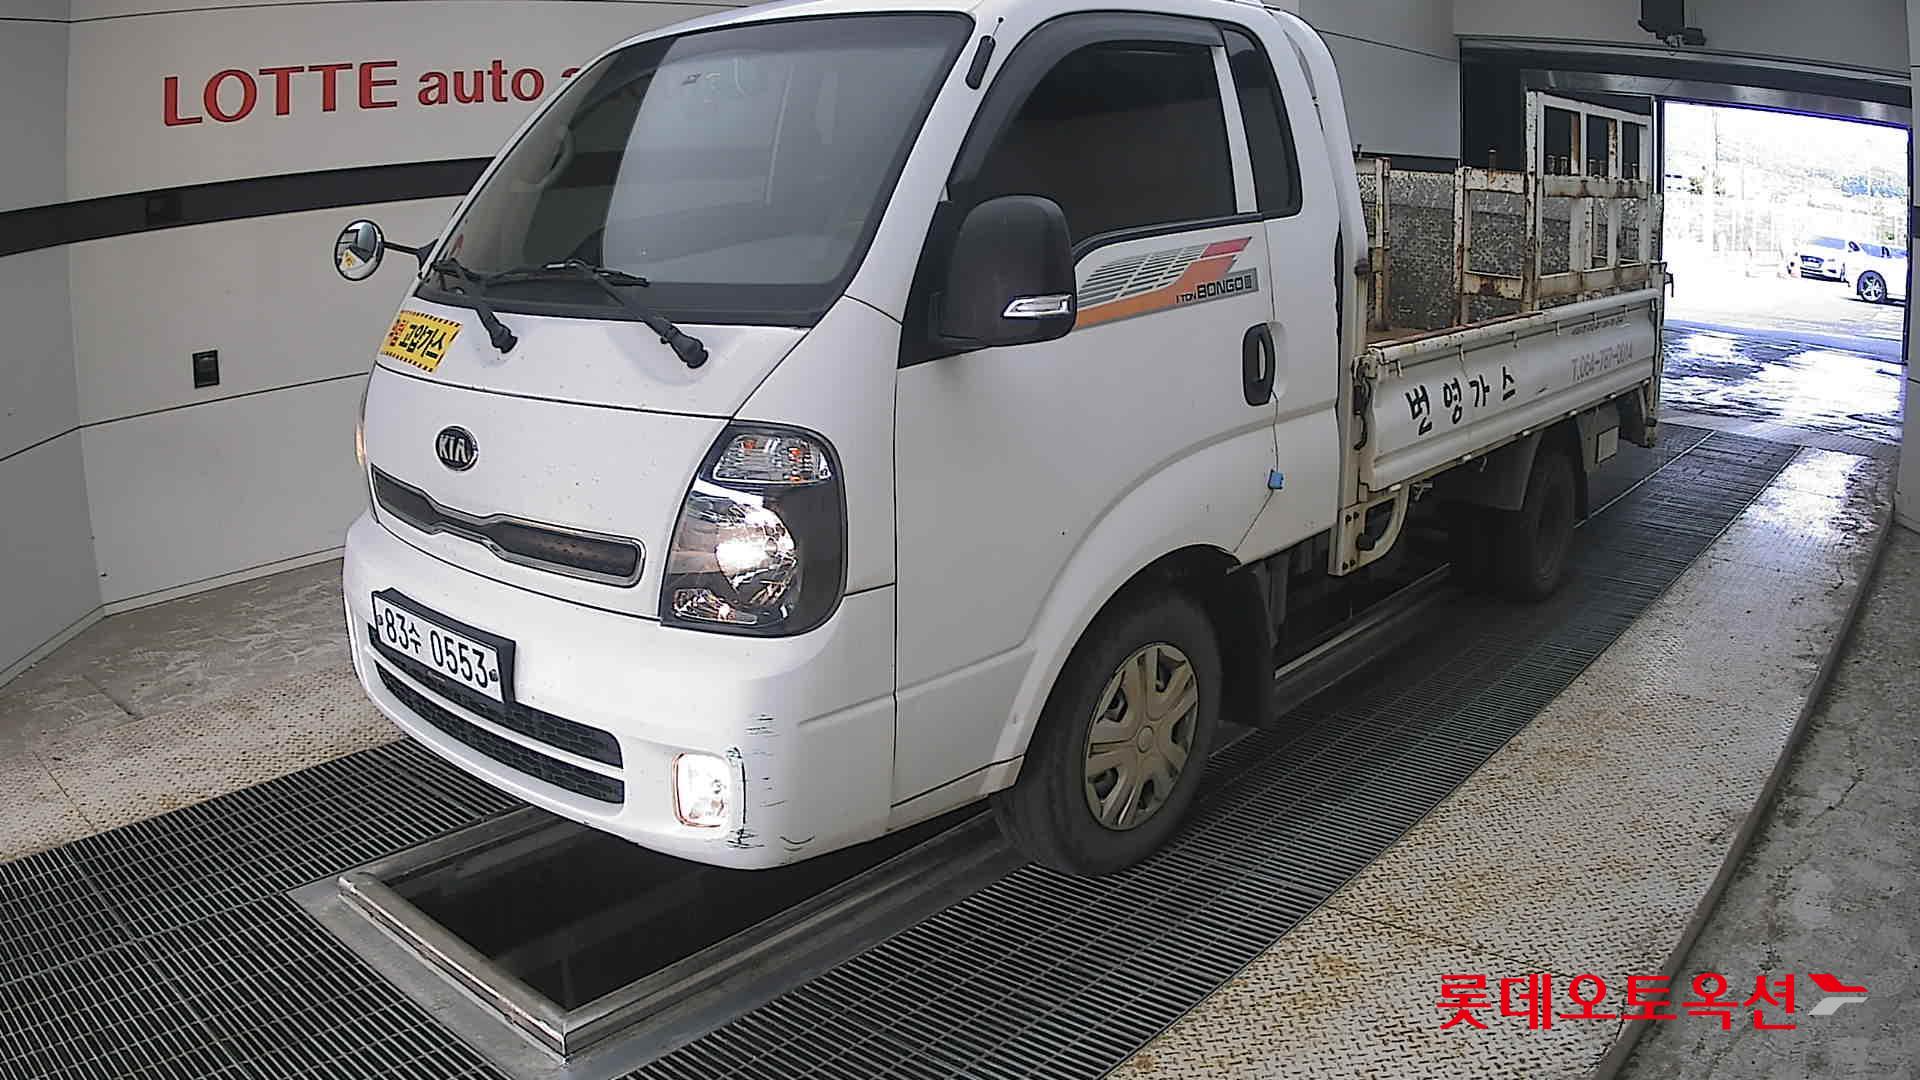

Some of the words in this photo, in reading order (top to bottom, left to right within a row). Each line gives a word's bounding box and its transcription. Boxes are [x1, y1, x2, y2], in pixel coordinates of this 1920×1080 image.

[163, 60, 399, 127] LOTTE
[417, 59, 545, 106] auto
[1197, 276, 1244, 299] BONGO
[398, 323, 447, 359] 고압가스
[438, 433, 469, 464] KIA
[384, 606, 423, 655] 83수
[429, 629, 489, 689] 0553
